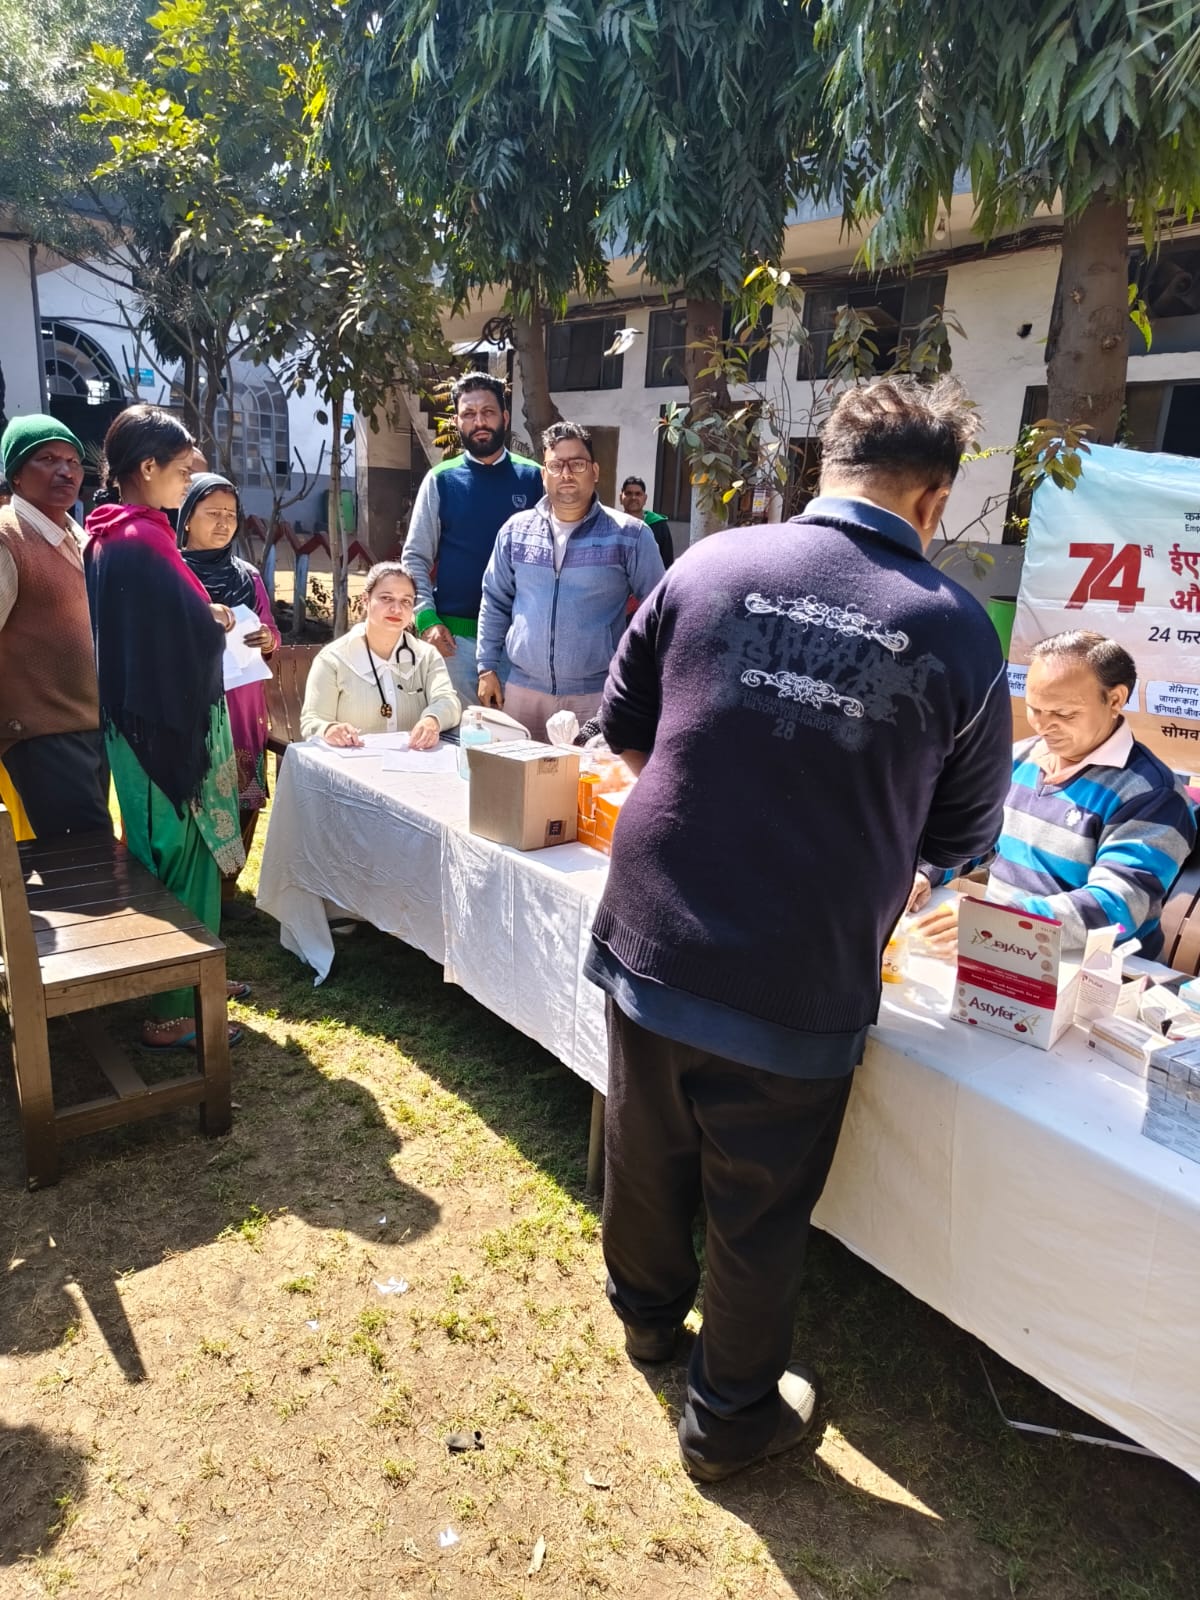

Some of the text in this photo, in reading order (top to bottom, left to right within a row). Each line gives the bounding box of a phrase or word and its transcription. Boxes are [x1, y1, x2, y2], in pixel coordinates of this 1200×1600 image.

[1065, 543, 1145, 613] 74
[1148, 626, 1171, 643] 24
[772, 719, 796, 740] 28
[992, 939, 1038, 961] Astyfer
[969, 996, 1017, 1020] Astyfer
